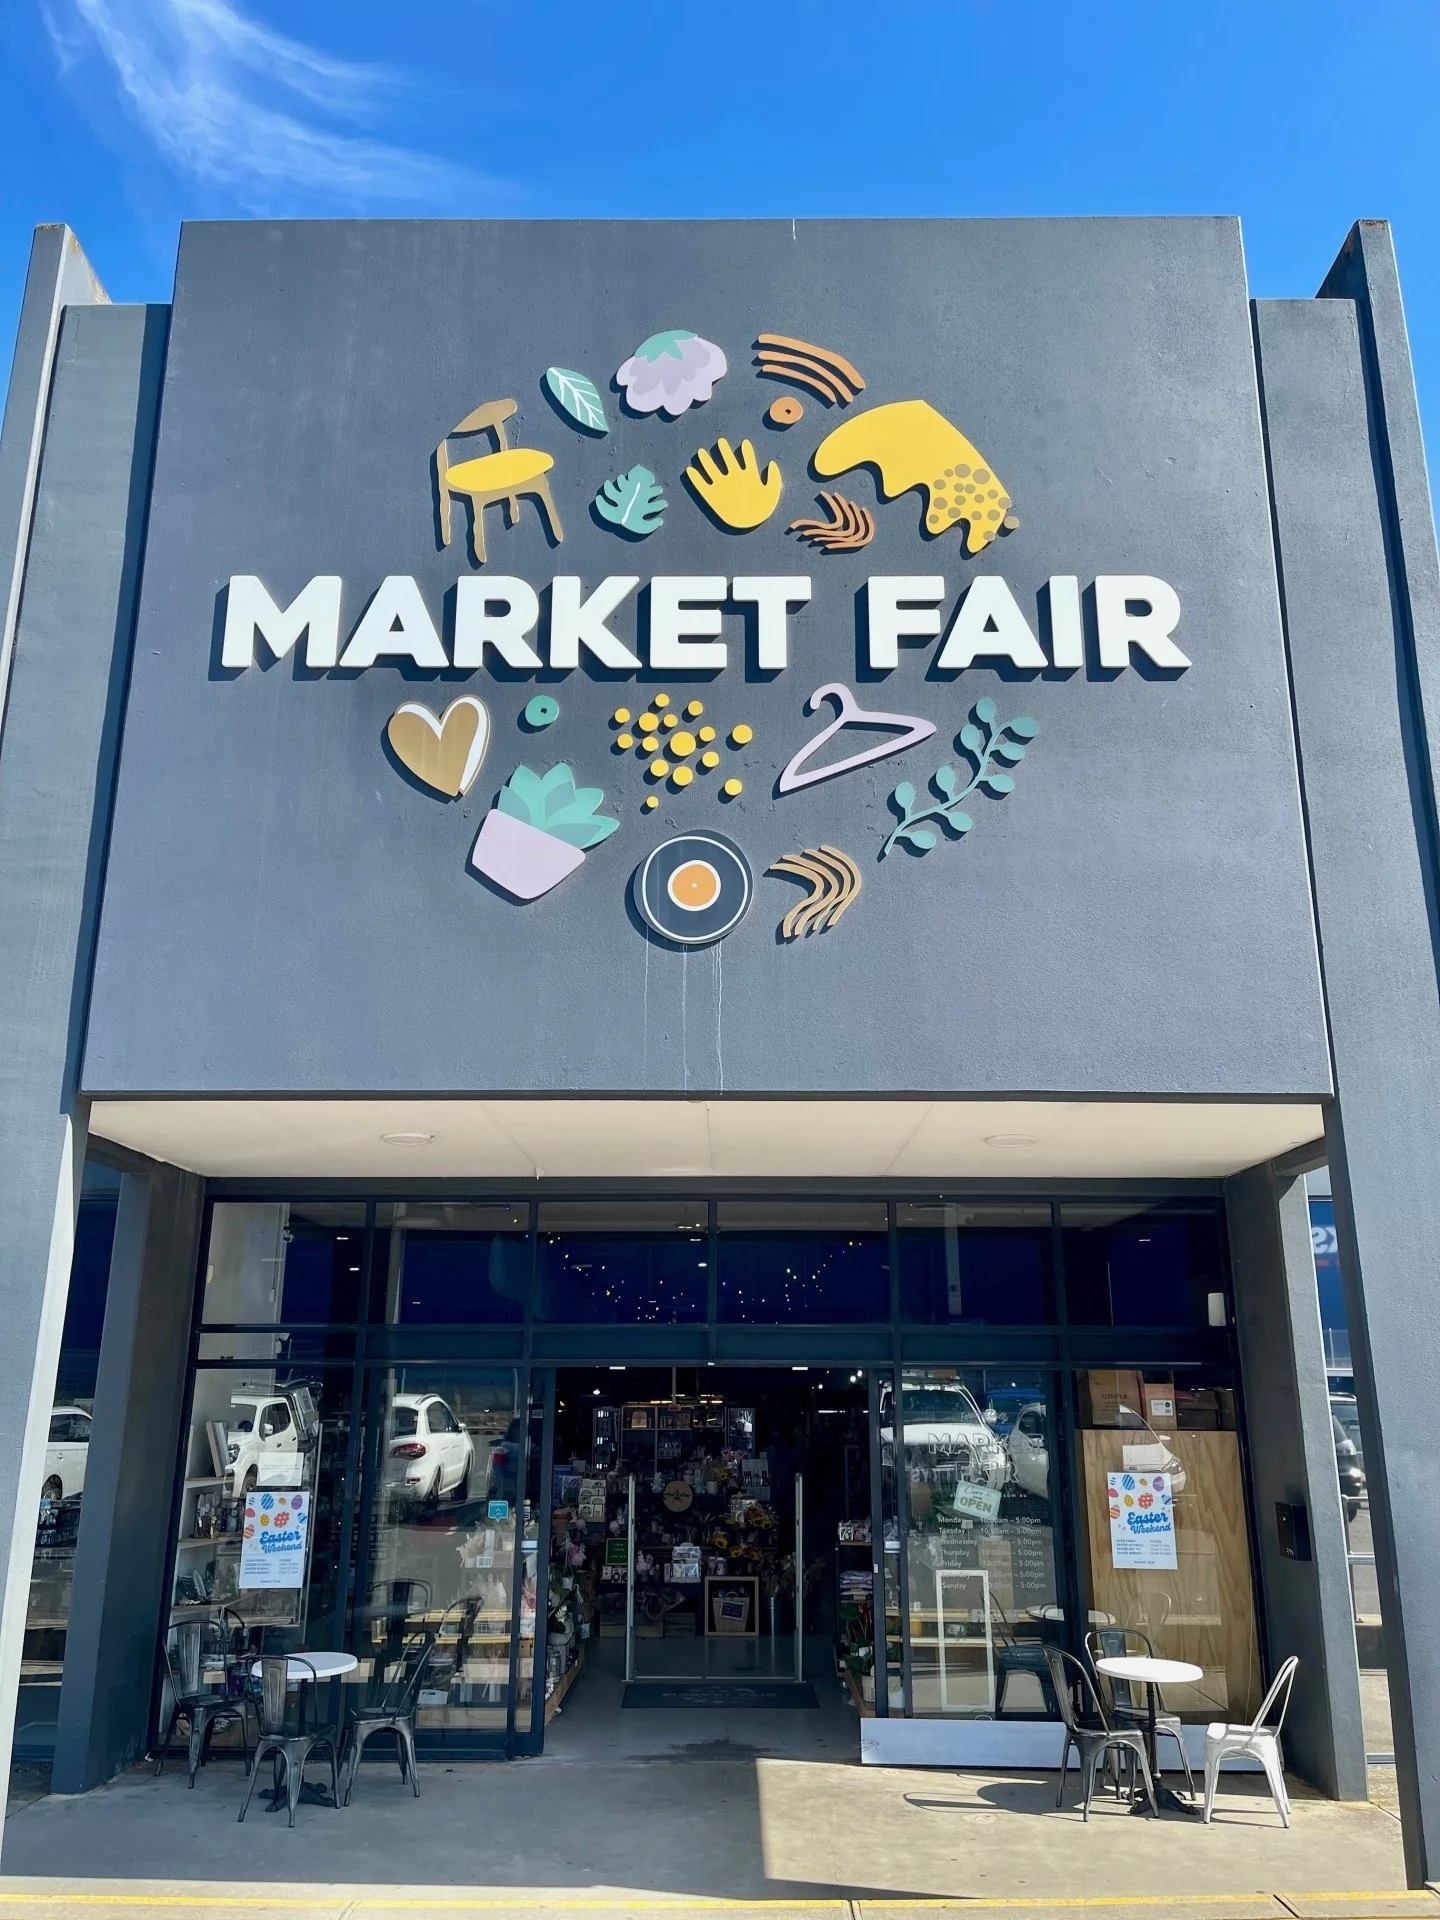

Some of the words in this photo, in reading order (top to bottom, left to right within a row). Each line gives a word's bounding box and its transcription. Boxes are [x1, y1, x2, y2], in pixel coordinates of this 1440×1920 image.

[221, 575, 812, 671] MARKET
[868, 575, 1192, 669] FAIR
[960, 1496, 992, 1513] OPEN
[1016, 1516, 1041, 1525] 5:00pm
[1127, 1511, 1168, 1526] Easter
[1130, 1522, 1171, 1534] Weekend
[260, 1531, 301, 1545] Easter
[1017, 1538, 1042, 1546] 5:00pm
[262, 1541, 302, 1553] Weekend
[1017, 1549, 1043, 1557] 5:00pm
[1019, 1560, 1044, 1568] 5:00pm
[1020, 1571, 1045, 1579] 5:00pm
[942, 1582, 967, 1590] Sunday
[1020, 1582, 1045, 1590] 5:00pm
